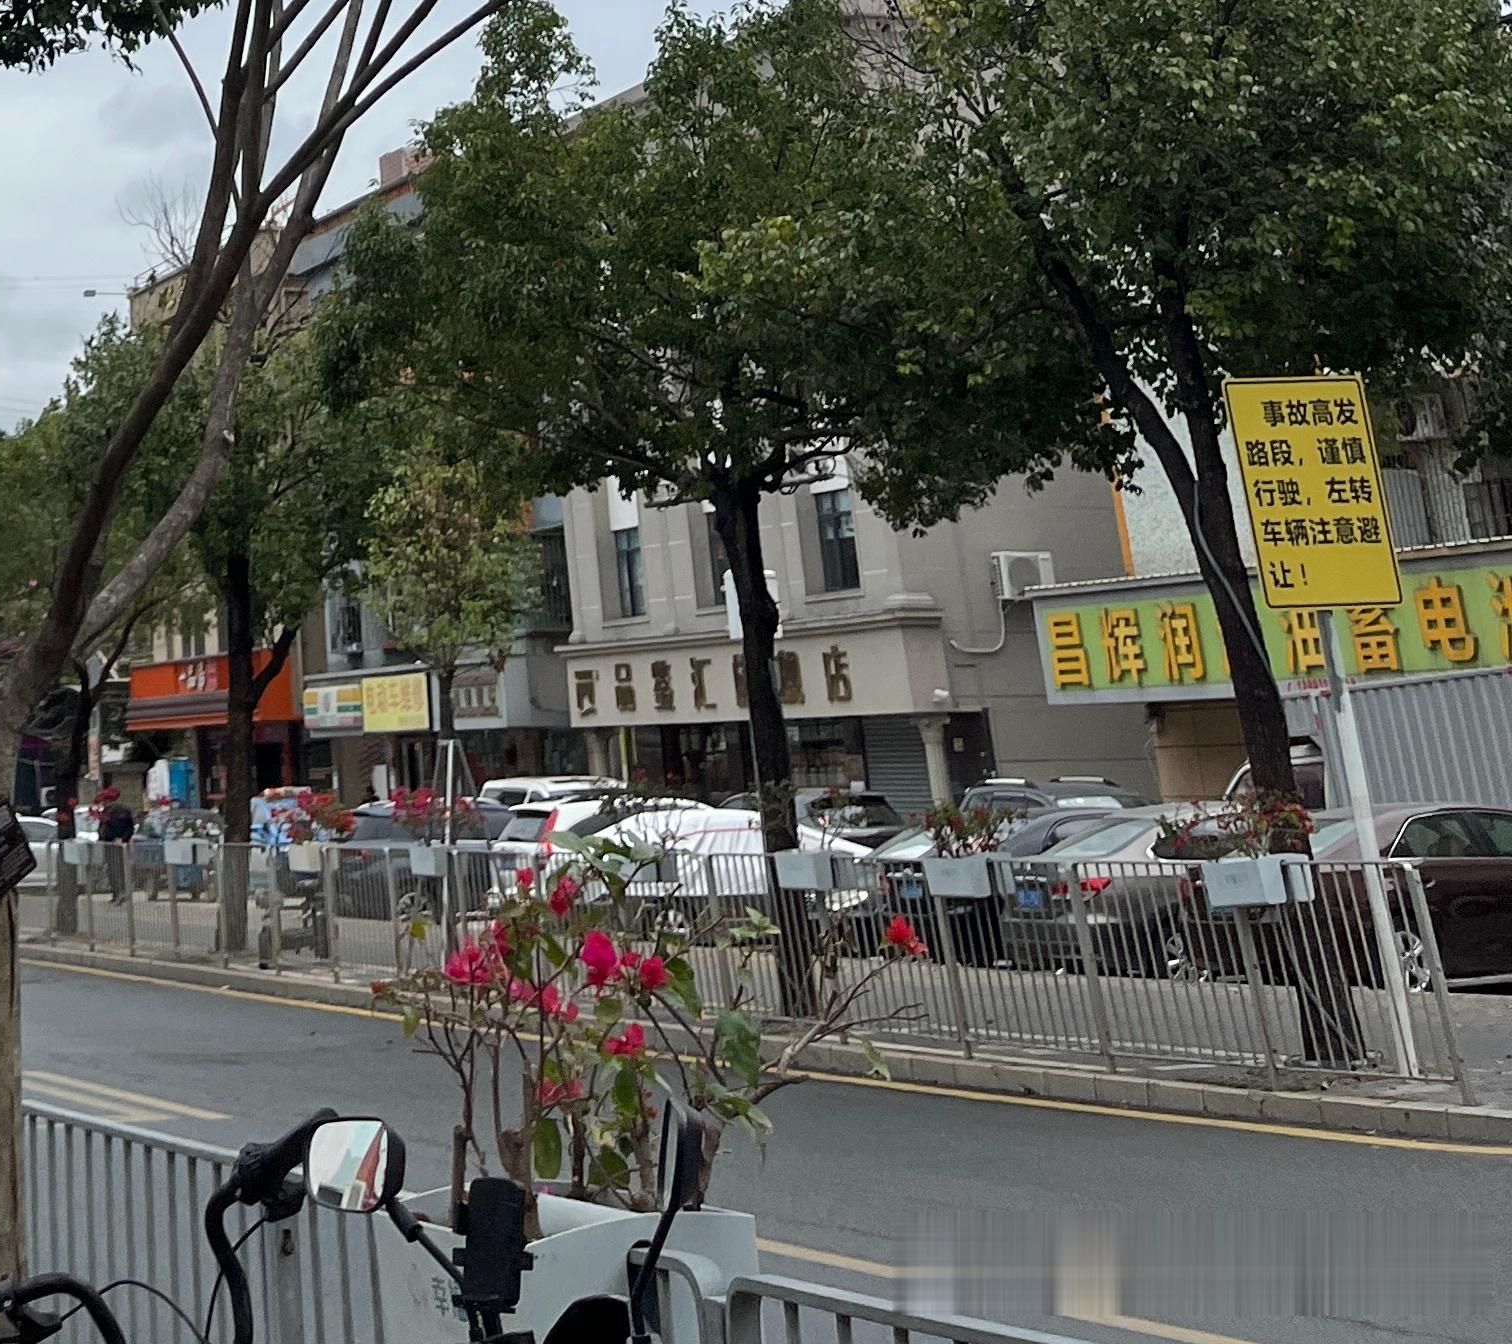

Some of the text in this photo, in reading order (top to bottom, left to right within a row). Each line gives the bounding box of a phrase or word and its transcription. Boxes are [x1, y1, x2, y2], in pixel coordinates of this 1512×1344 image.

[1261, 398, 1358, 427] 事故高发
[1245, 437, 1366, 466] 路段，谨慎
[1253, 476, 1372, 507] 行驶，左转
[1261, 517, 1382, 546] 车辆注意避
[1270, 560, 1308, 588] 让！
[1048, 568, 1512, 689] 昌辉润油蓄电
